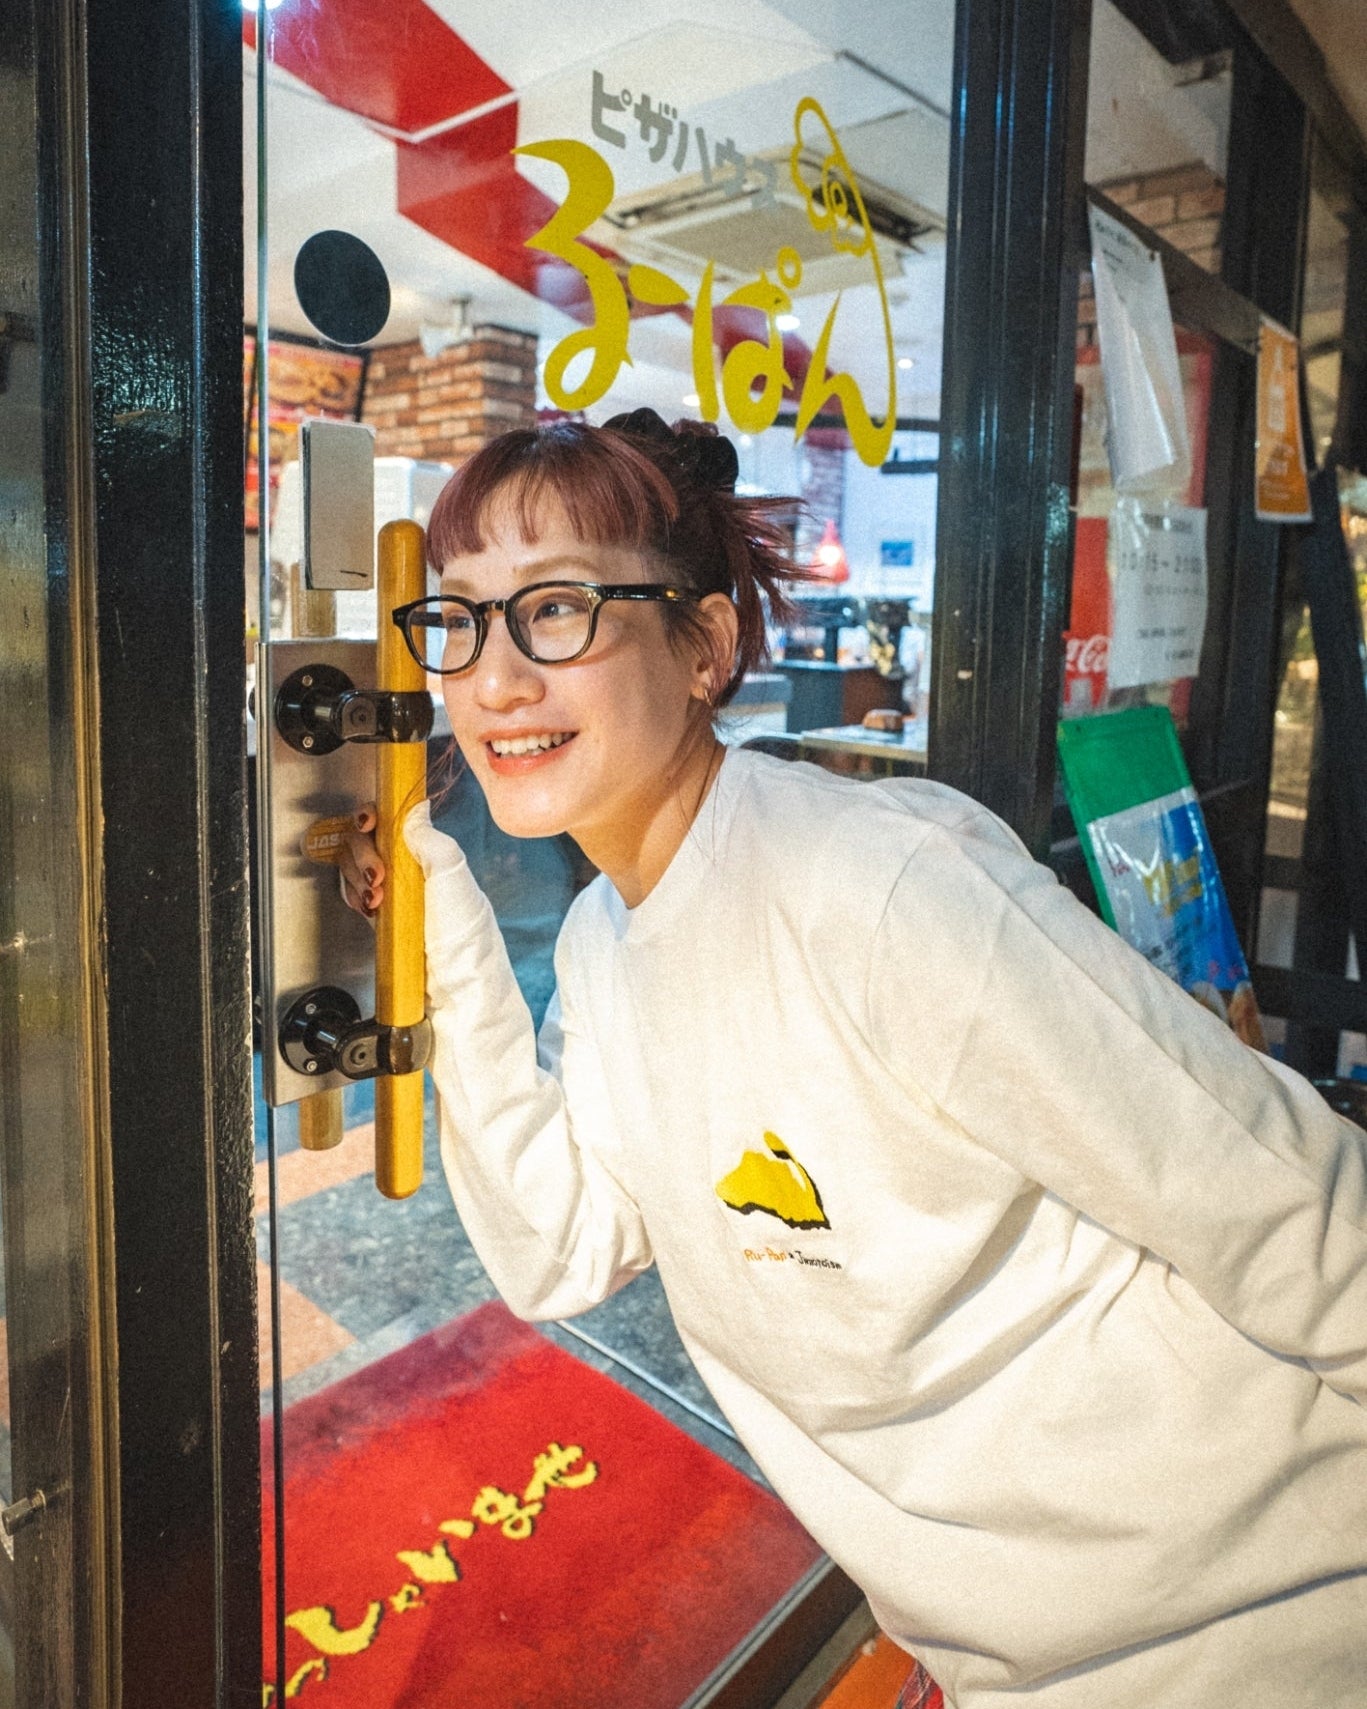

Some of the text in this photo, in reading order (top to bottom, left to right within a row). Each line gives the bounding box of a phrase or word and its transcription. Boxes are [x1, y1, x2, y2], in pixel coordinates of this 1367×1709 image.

[591, 70, 778, 209] ピザハウス
[306, 832, 344, 850] JAS
